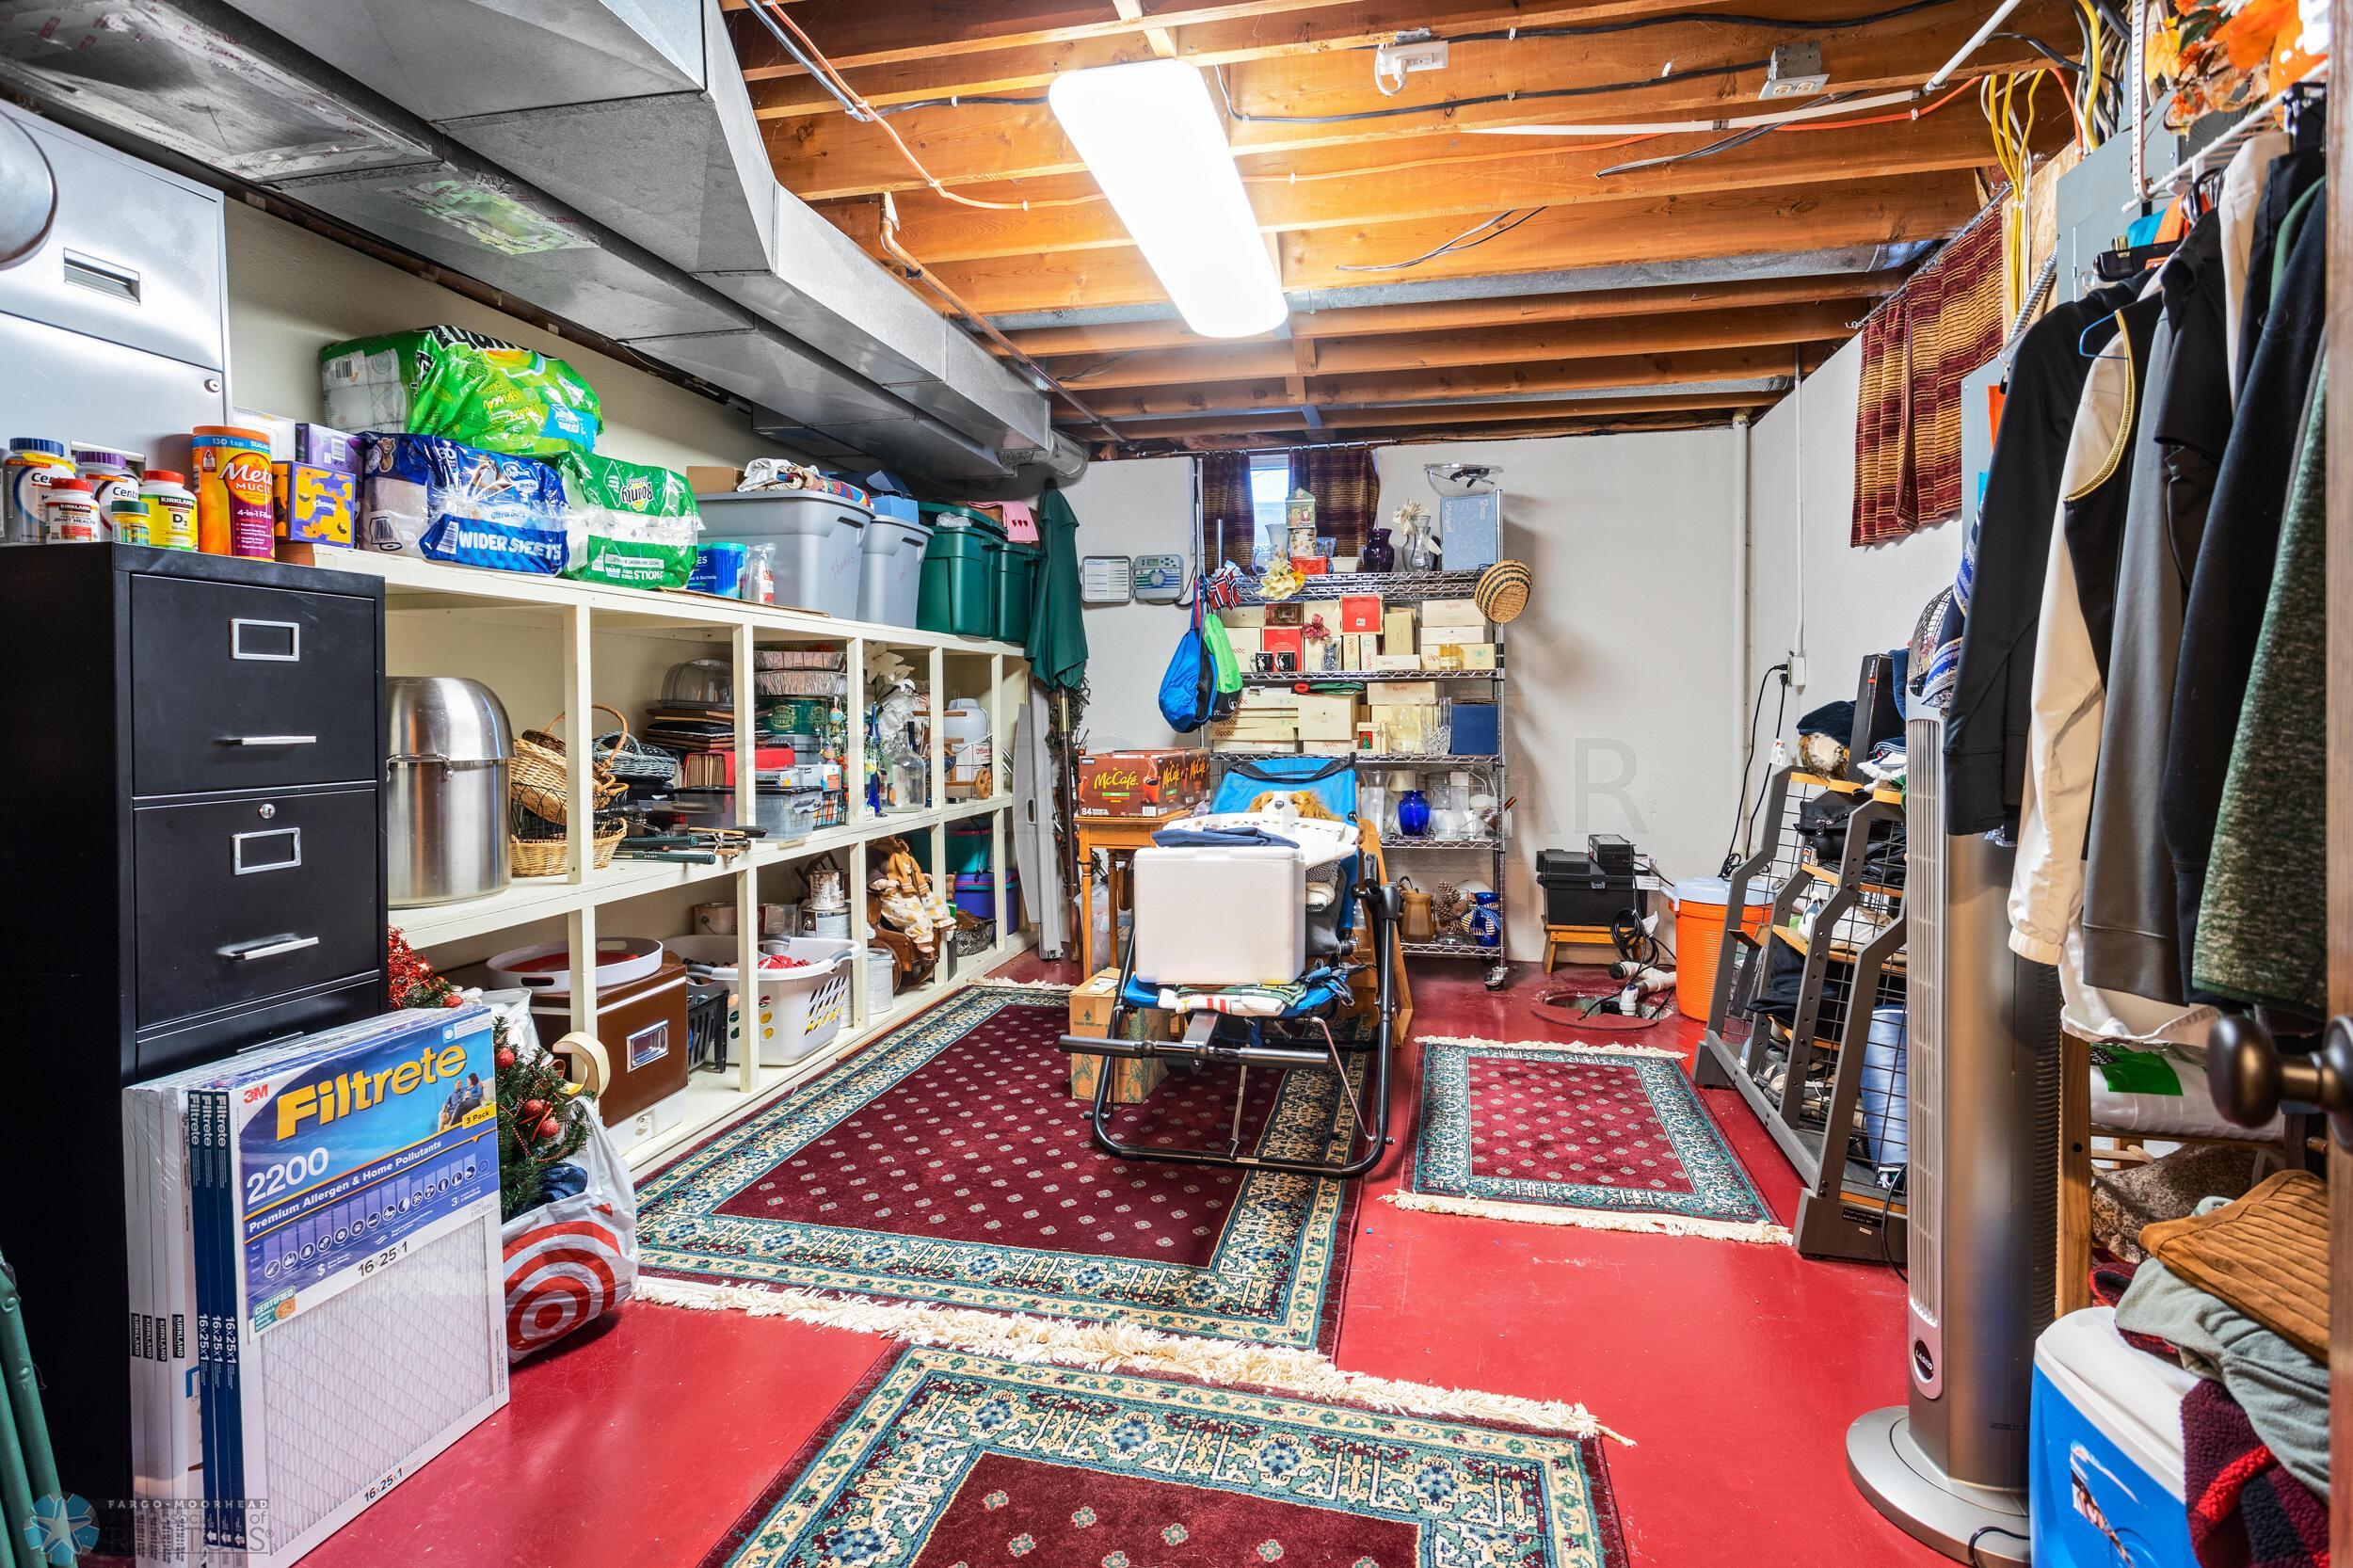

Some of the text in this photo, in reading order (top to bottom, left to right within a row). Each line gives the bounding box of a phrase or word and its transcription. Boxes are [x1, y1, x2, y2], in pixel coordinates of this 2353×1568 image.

[313, 499, 337, 511] Kleenex
[621, 482, 654, 504] Bounty
[458, 530, 563, 561] WIDER SHEETS
[1215, 728, 1235, 737] Spode
[1218, 718, 1238, 727] Spode
[1162, 760, 1180, 789] McCafé
[1081, 808, 1092, 816] 84
[243, 1083, 269, 1104] 3M
[276, 1045, 468, 1142] Filtrete
[189, 1094, 200, 1145] Filtrete
[201, 1095, 213, 1147] Filtrete
[216, 1095, 228, 1147] Filtrete
[465, 1110, 490, 1124] 3 Pack
[247, 1146, 329, 1206] 2200
[248, 1140, 442, 1234] Premium Allergen & Home Pollutants
[255, 1287, 294, 1316] CERTIFIED
[199, 1313, 210, 1361] 16x25x1
[213, 1315, 223, 1363] 16x25x1
[225, 1316, 237, 1364] 16x25x1
[1915, 1349, 1933, 1371] LASKO
